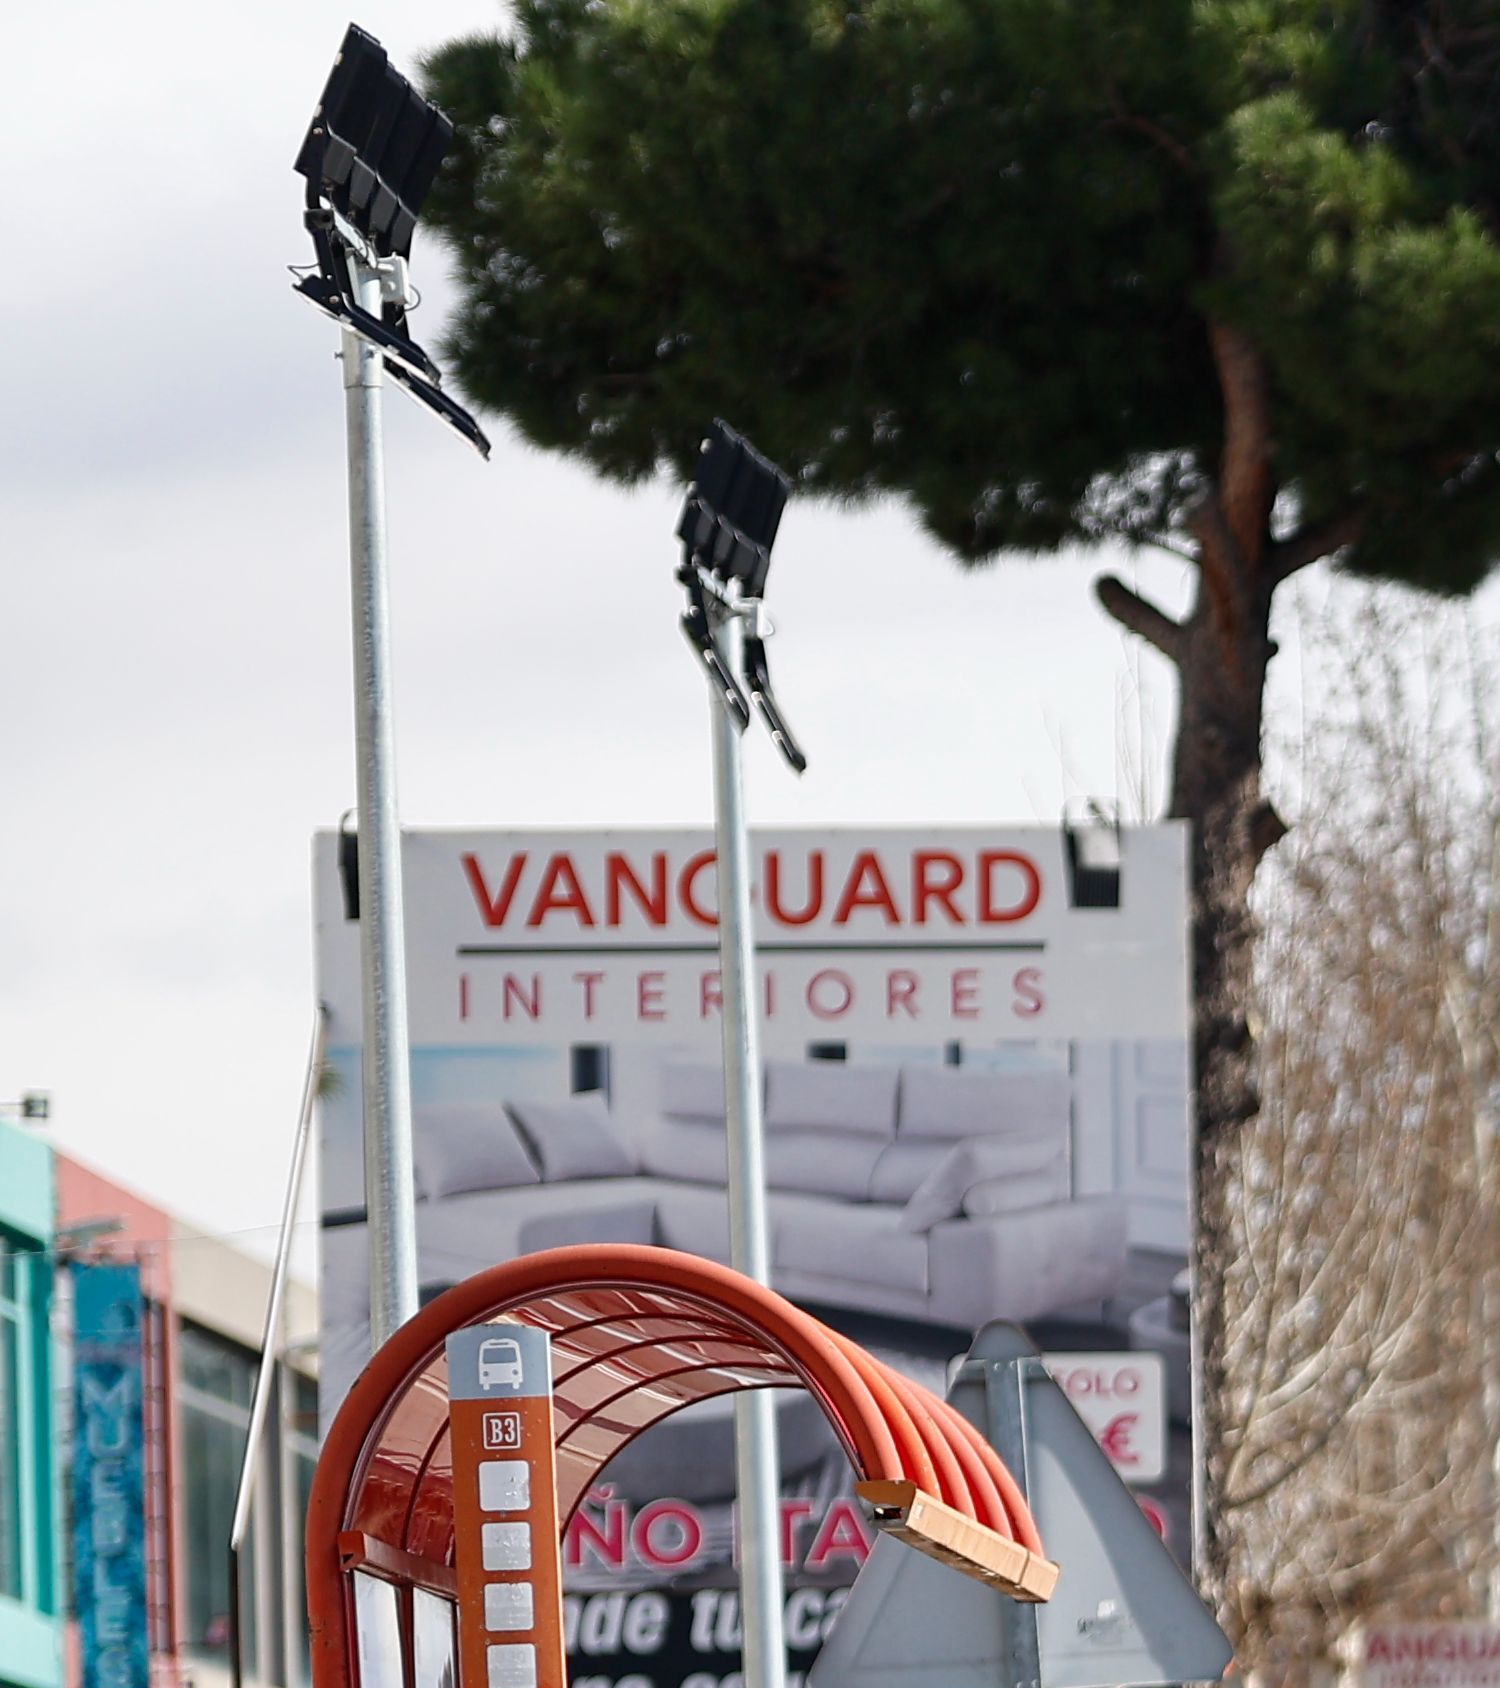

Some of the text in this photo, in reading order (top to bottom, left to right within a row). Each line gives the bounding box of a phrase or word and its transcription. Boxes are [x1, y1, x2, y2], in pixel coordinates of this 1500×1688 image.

[1056, 1367, 1139, 1396] OLO
[490, 1418, 516, 1443] B3
[81, 1368, 132, 1687] MUEBLES
